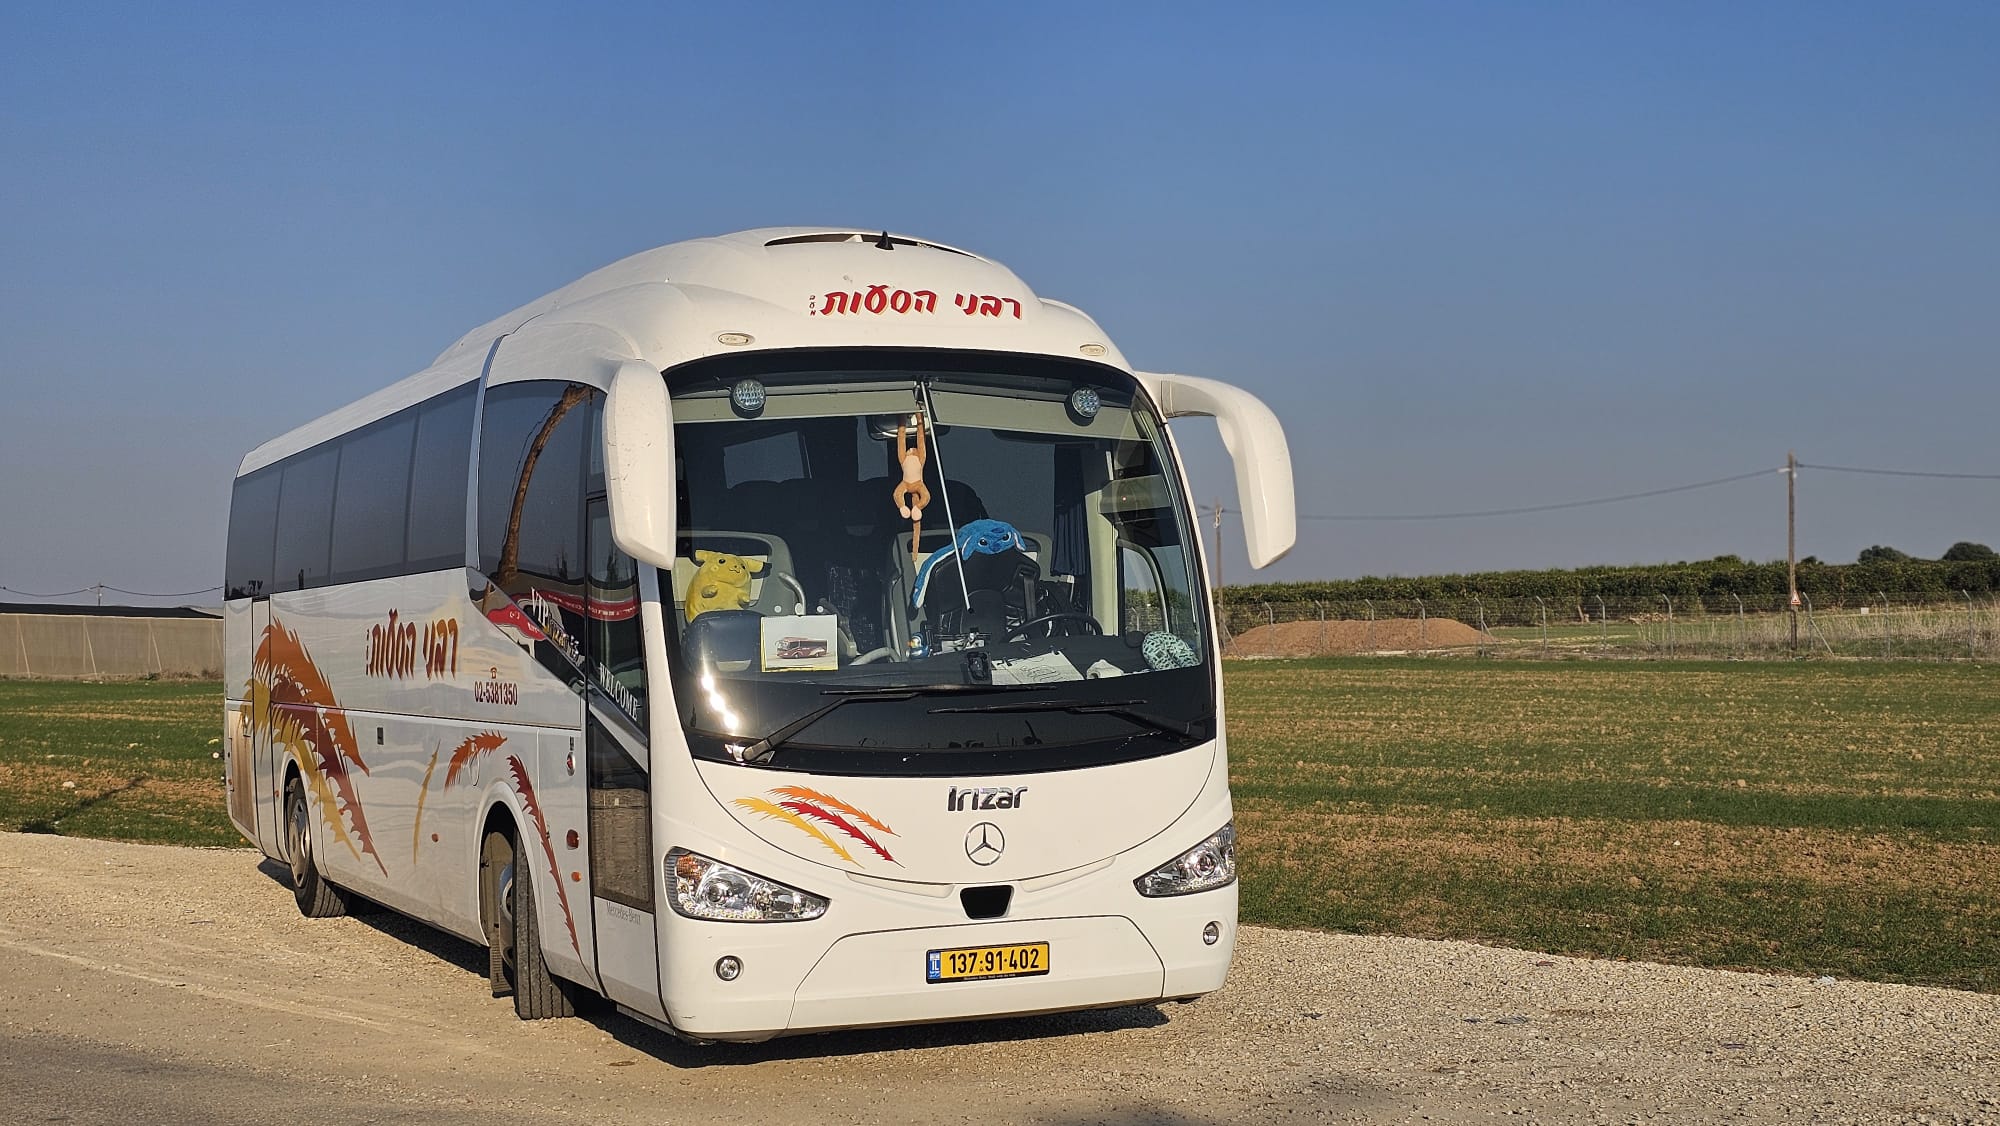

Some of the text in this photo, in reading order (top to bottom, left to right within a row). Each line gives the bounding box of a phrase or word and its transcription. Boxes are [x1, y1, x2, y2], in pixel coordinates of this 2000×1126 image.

[820, 284, 1022, 319] רבני הסעות
[530, 586, 550, 629] VIP
[369, 607, 417, 681] הסעות
[422, 617, 459, 681] רבני
[474, 680, 518, 706] 02-5381350
[599, 661, 638, 722] WELCOME
